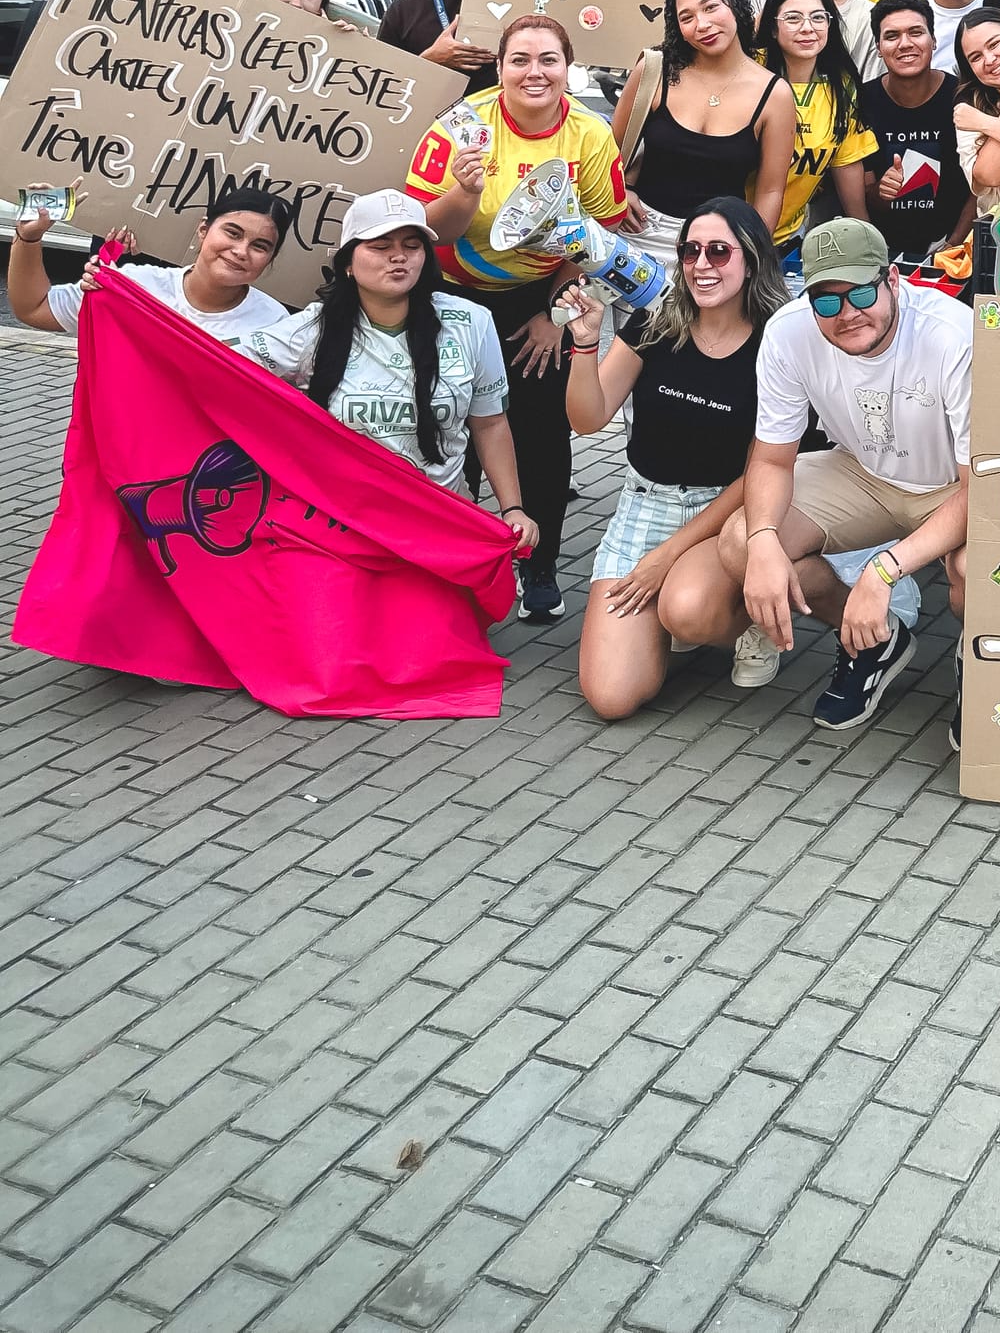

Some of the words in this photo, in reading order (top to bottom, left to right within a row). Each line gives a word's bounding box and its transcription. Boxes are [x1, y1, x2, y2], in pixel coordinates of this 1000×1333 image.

[322, 57, 405, 112] ESTE
[885, 130, 941, 142] TOMMY
[440, 309, 472, 324] ESSA
[658, 385, 684, 399] Calvin
[685, 393, 706, 405] Klein
[707, 400, 732, 412] Jeans
[349, 401, 451, 424] RIVAO
